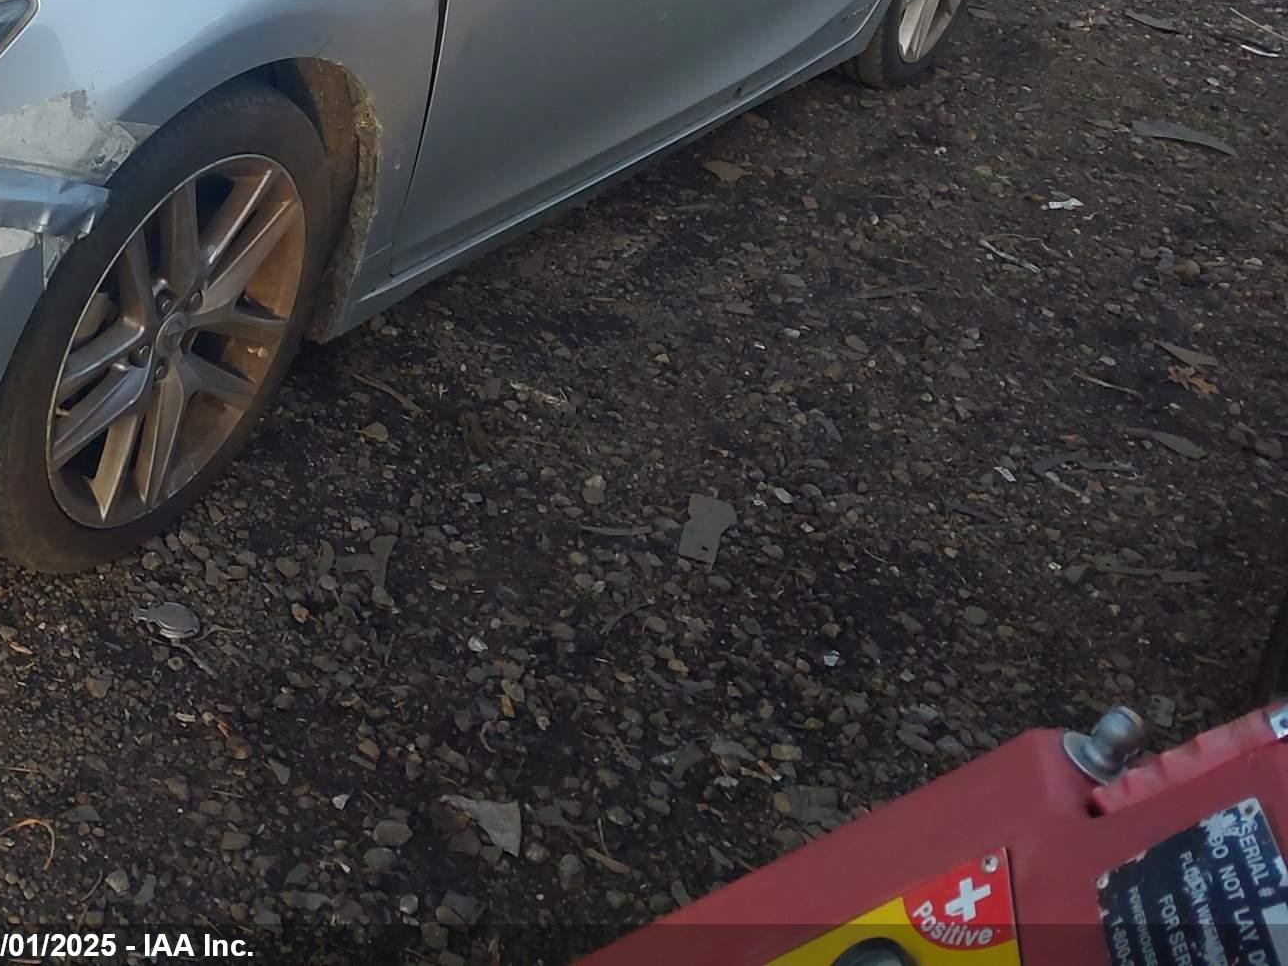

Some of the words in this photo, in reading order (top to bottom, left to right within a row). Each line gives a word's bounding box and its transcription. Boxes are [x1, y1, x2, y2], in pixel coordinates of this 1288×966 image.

[1239, 824, 1270, 885] SERIAL
[912, 899, 993, 946] Positive
[1158, 893, 1180, 930] FOR
[1219, 865, 1246, 899] NOT
[1233, 907, 1260, 942] LAY
